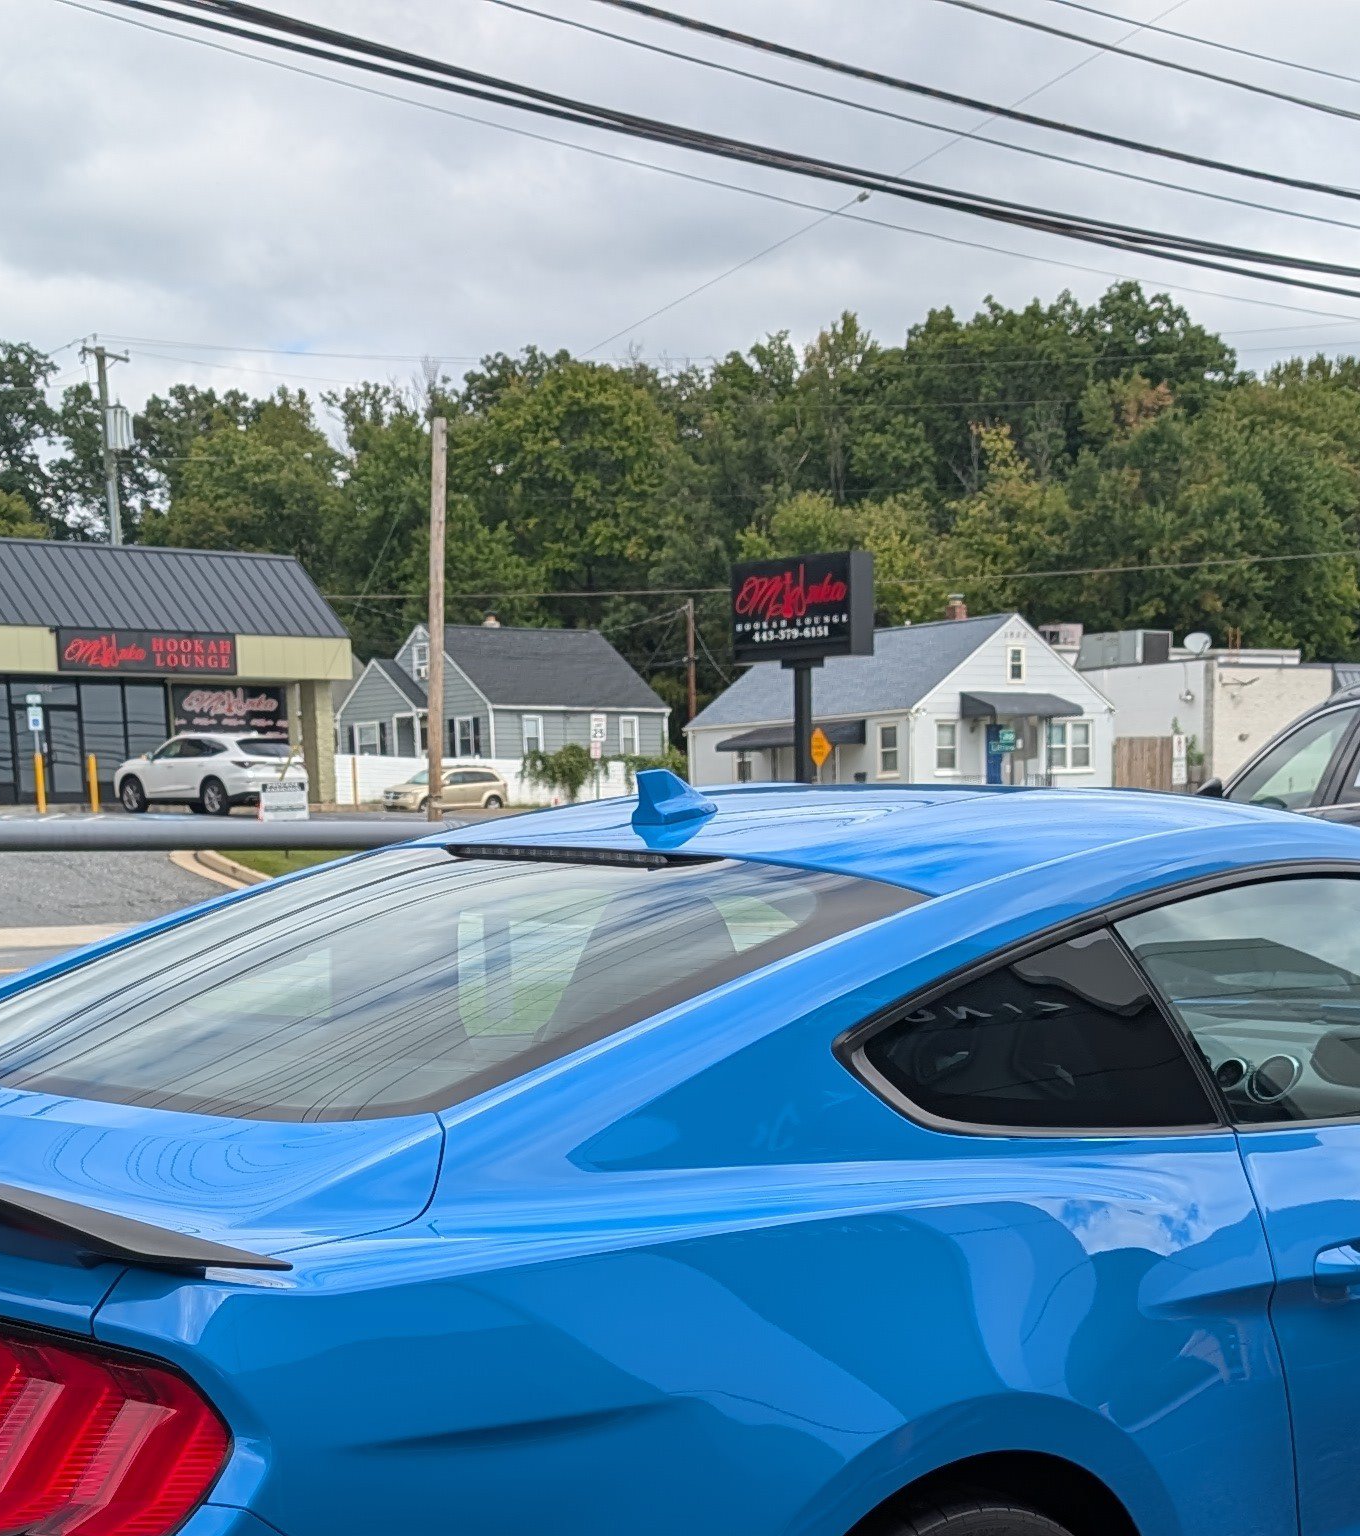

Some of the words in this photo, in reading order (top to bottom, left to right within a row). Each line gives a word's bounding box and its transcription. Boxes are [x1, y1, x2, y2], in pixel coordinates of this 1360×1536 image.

[795, 613, 849, 627] LOUNGE
[151, 637, 232, 654] HOOKAH
[155, 653, 231, 668] LOUNGE
